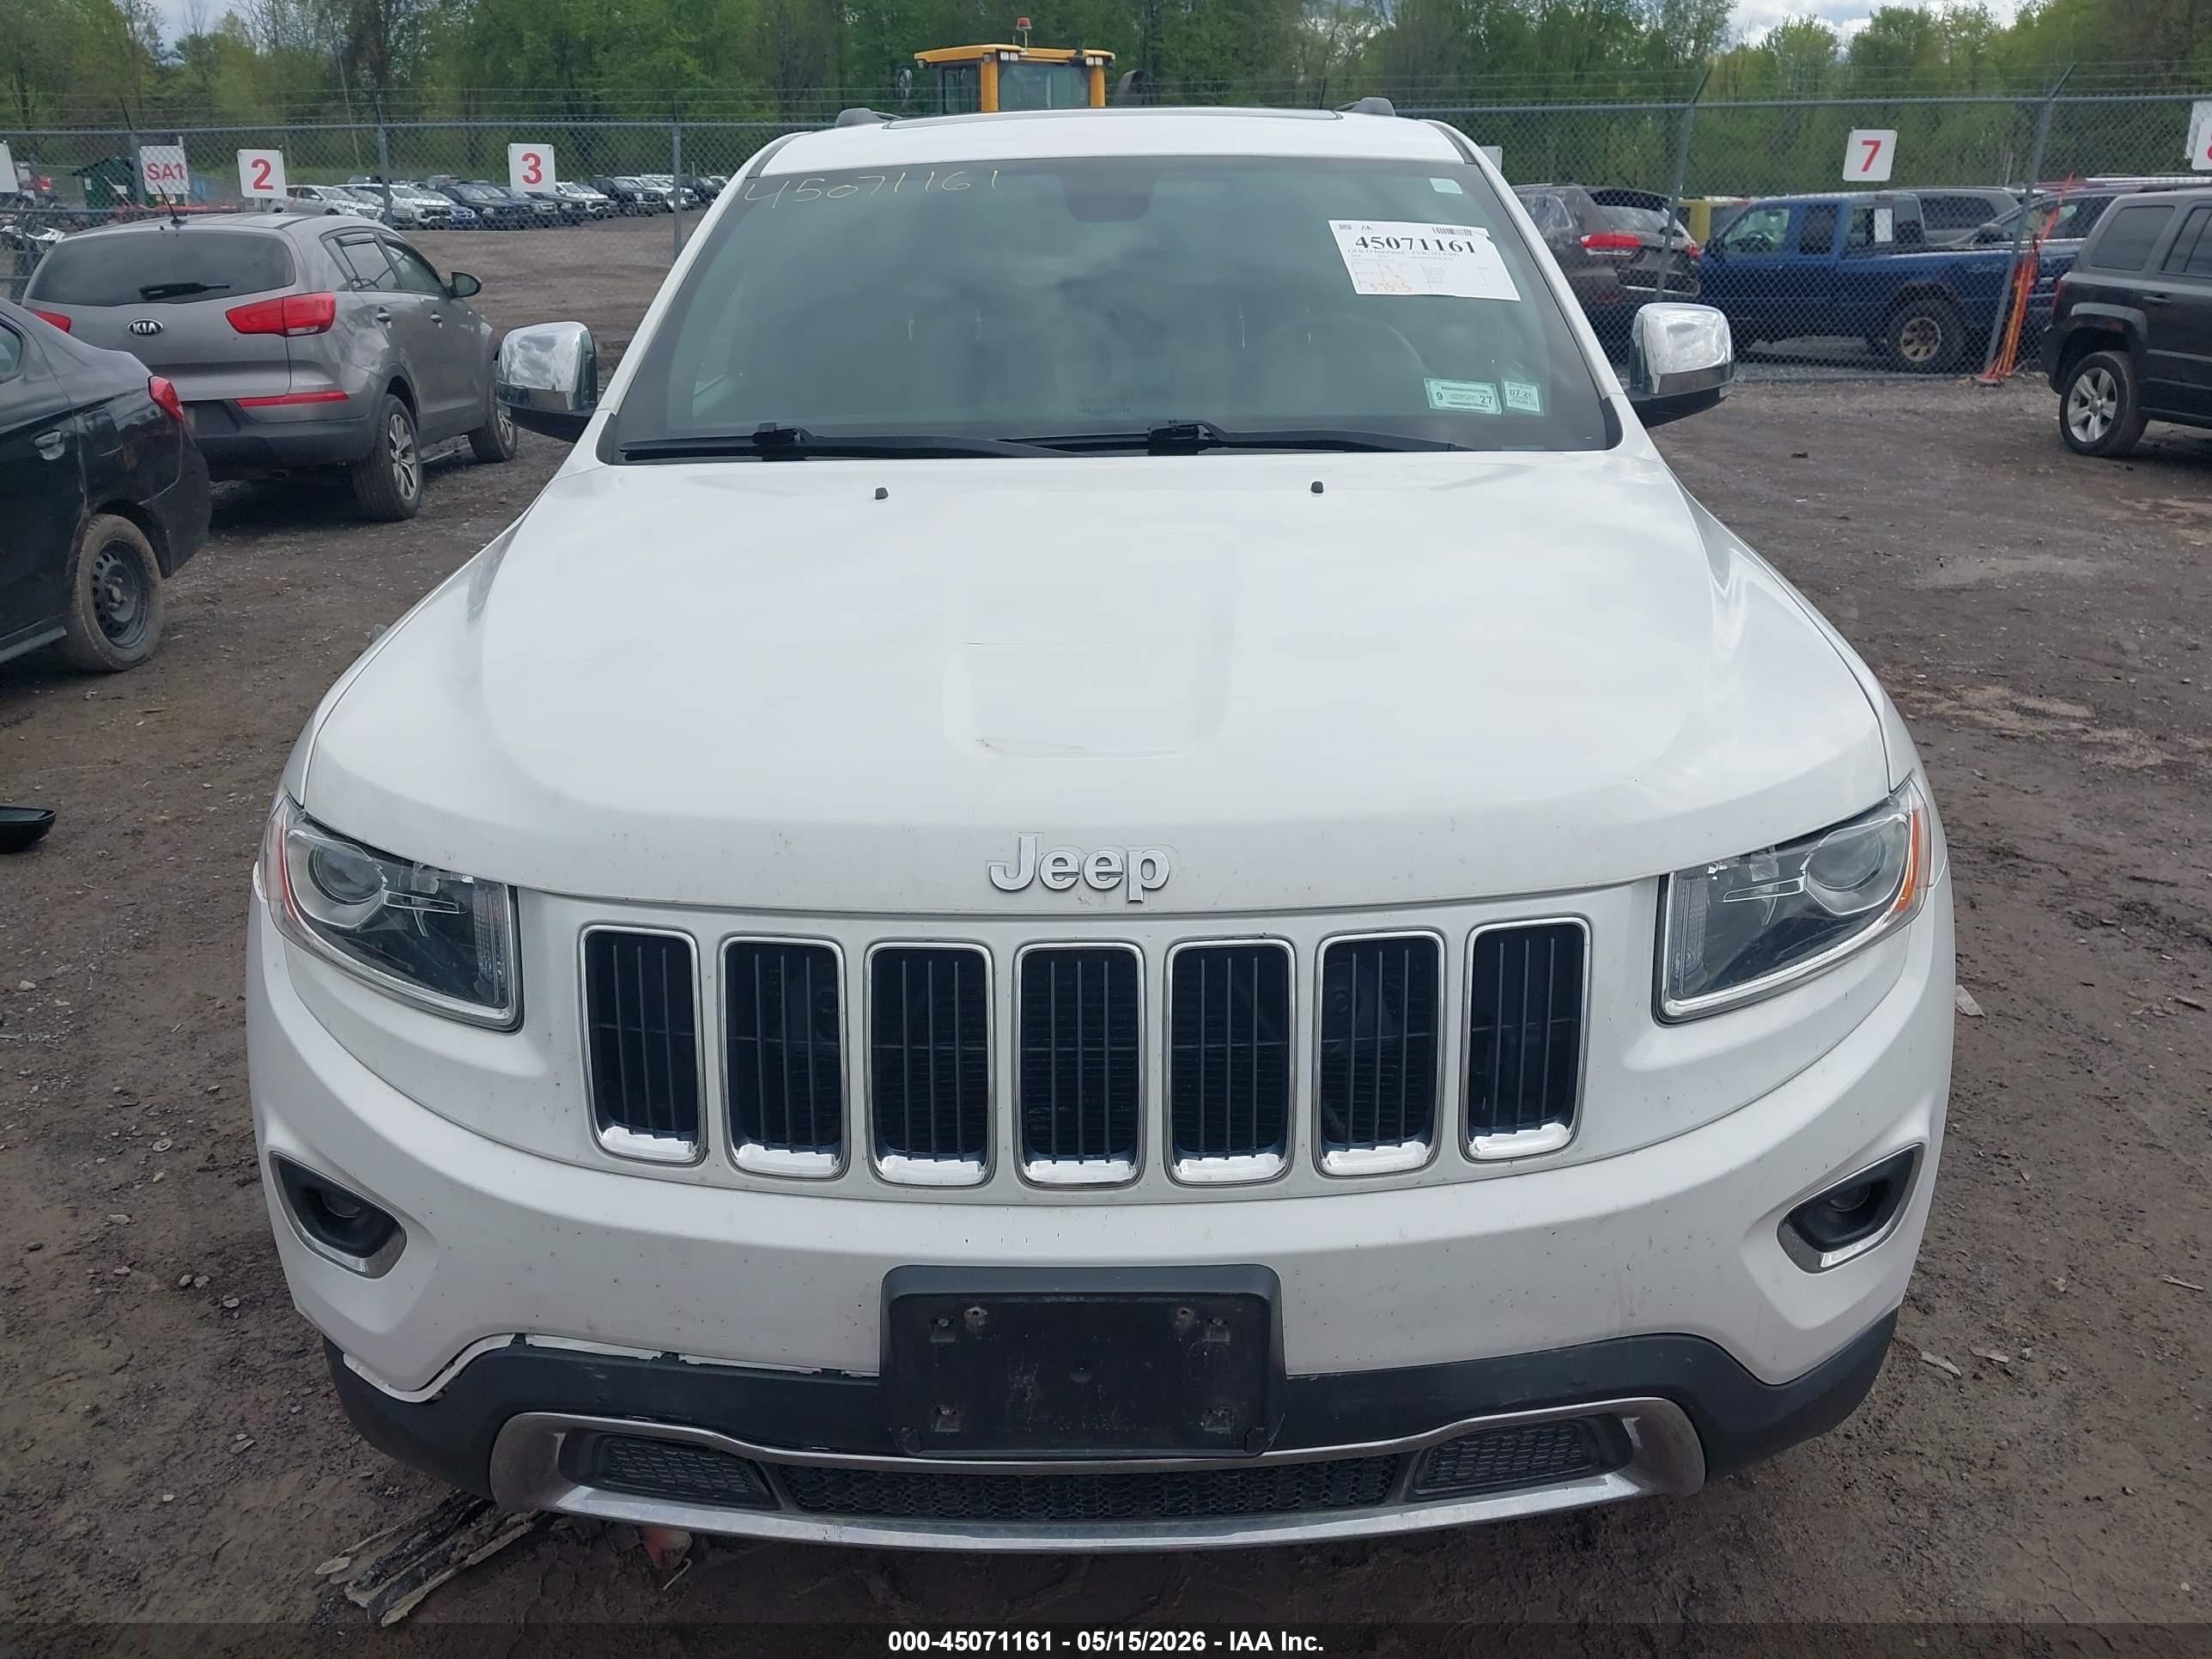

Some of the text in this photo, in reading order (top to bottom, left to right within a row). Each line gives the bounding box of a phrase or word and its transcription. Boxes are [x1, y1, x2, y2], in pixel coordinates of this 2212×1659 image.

[146, 162, 185, 180] SA1
[521, 153, 542, 185] 3
[1862, 140, 1881, 172] 7
[251, 159, 274, 190] 2
[744, 170, 998, 210] 45071161
[1355, 235, 1476, 254] 45071161
[132, 322, 158, 334] KIA
[1479, 395, 1492, 404] 27
[989, 836, 1170, 903] Jeep
